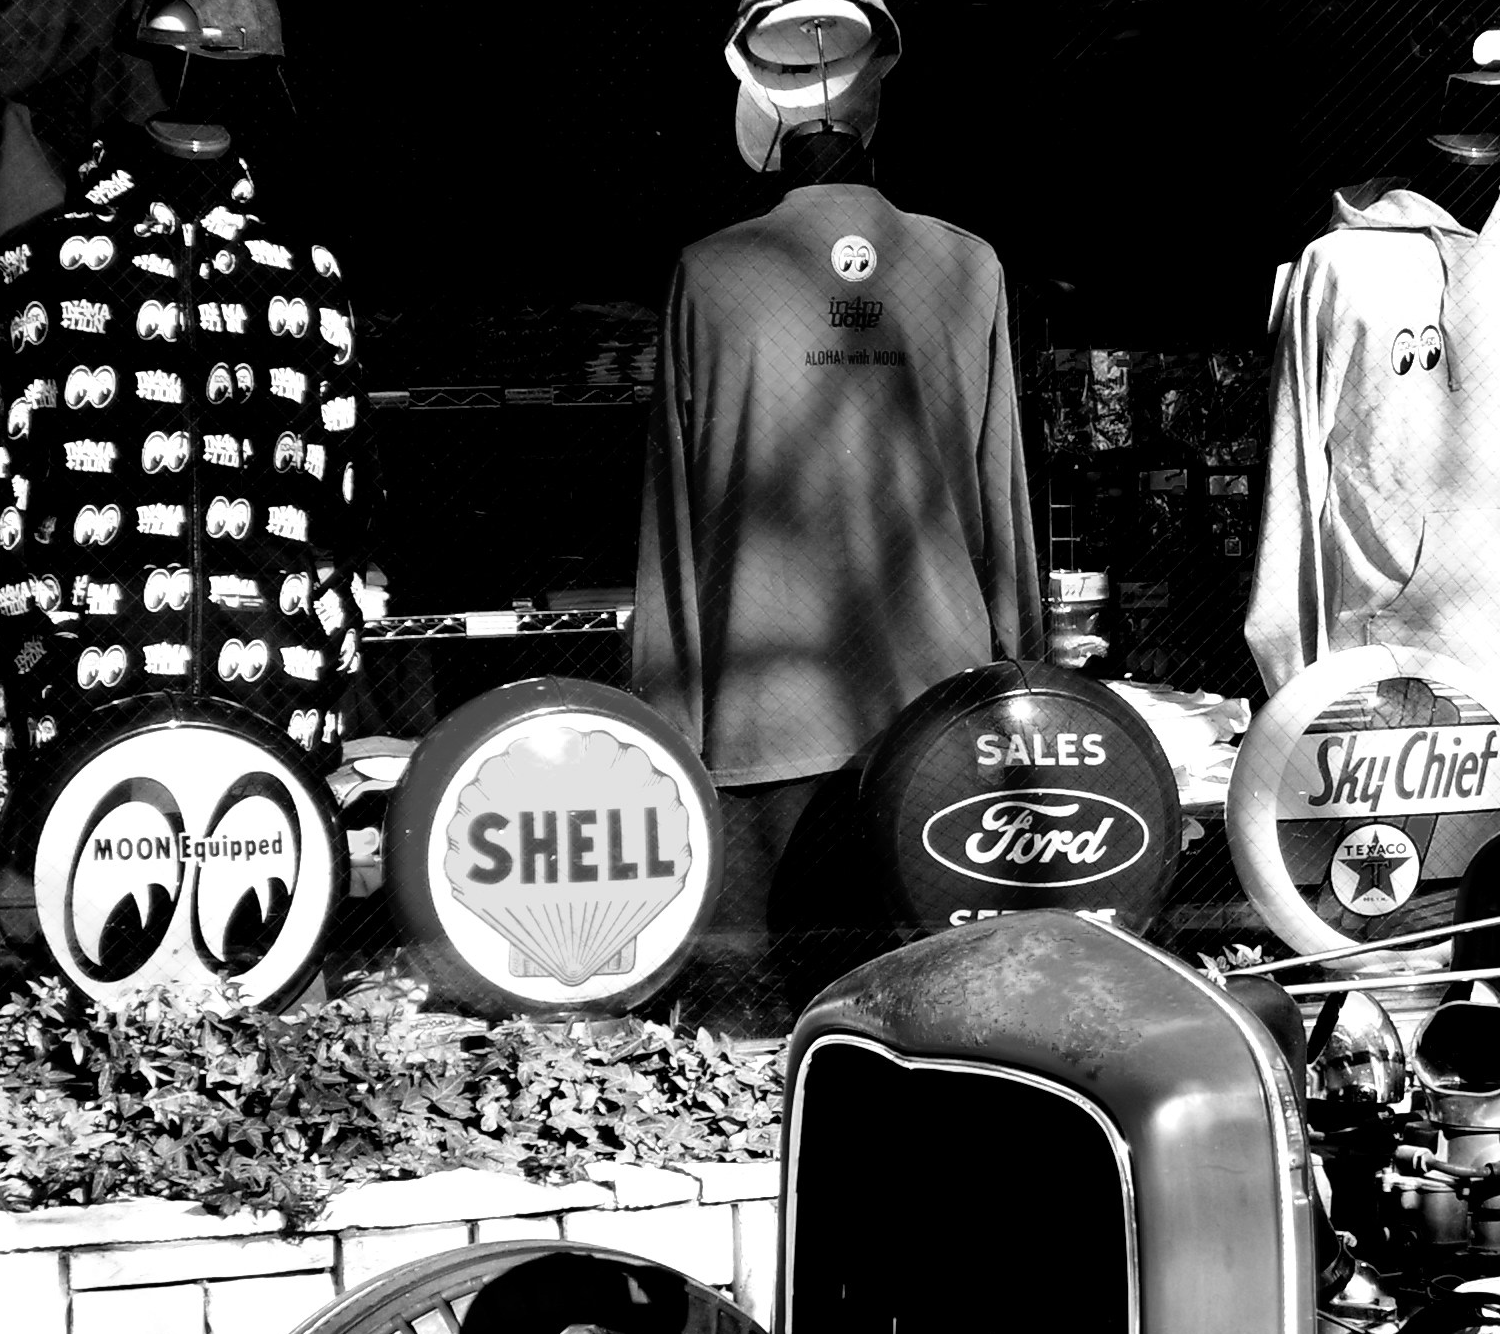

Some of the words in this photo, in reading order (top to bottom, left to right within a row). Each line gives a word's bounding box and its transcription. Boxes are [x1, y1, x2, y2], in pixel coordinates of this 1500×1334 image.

[805, 350, 845, 366] ALOHA!
[847, 348, 871, 366] with
[873, 350, 907, 366] MOON
[975, 732, 1107, 767] SALES
[1308, 734, 1392, 813] Sky
[1394, 729, 1499, 801] Chief
[93, 835, 172, 862] MOON
[180, 830, 283, 865] Equipped
[467, 806, 676, 886] SHELL
[964, 799, 1116, 865] Ford
[1343, 842, 1407, 857] TEXACO
